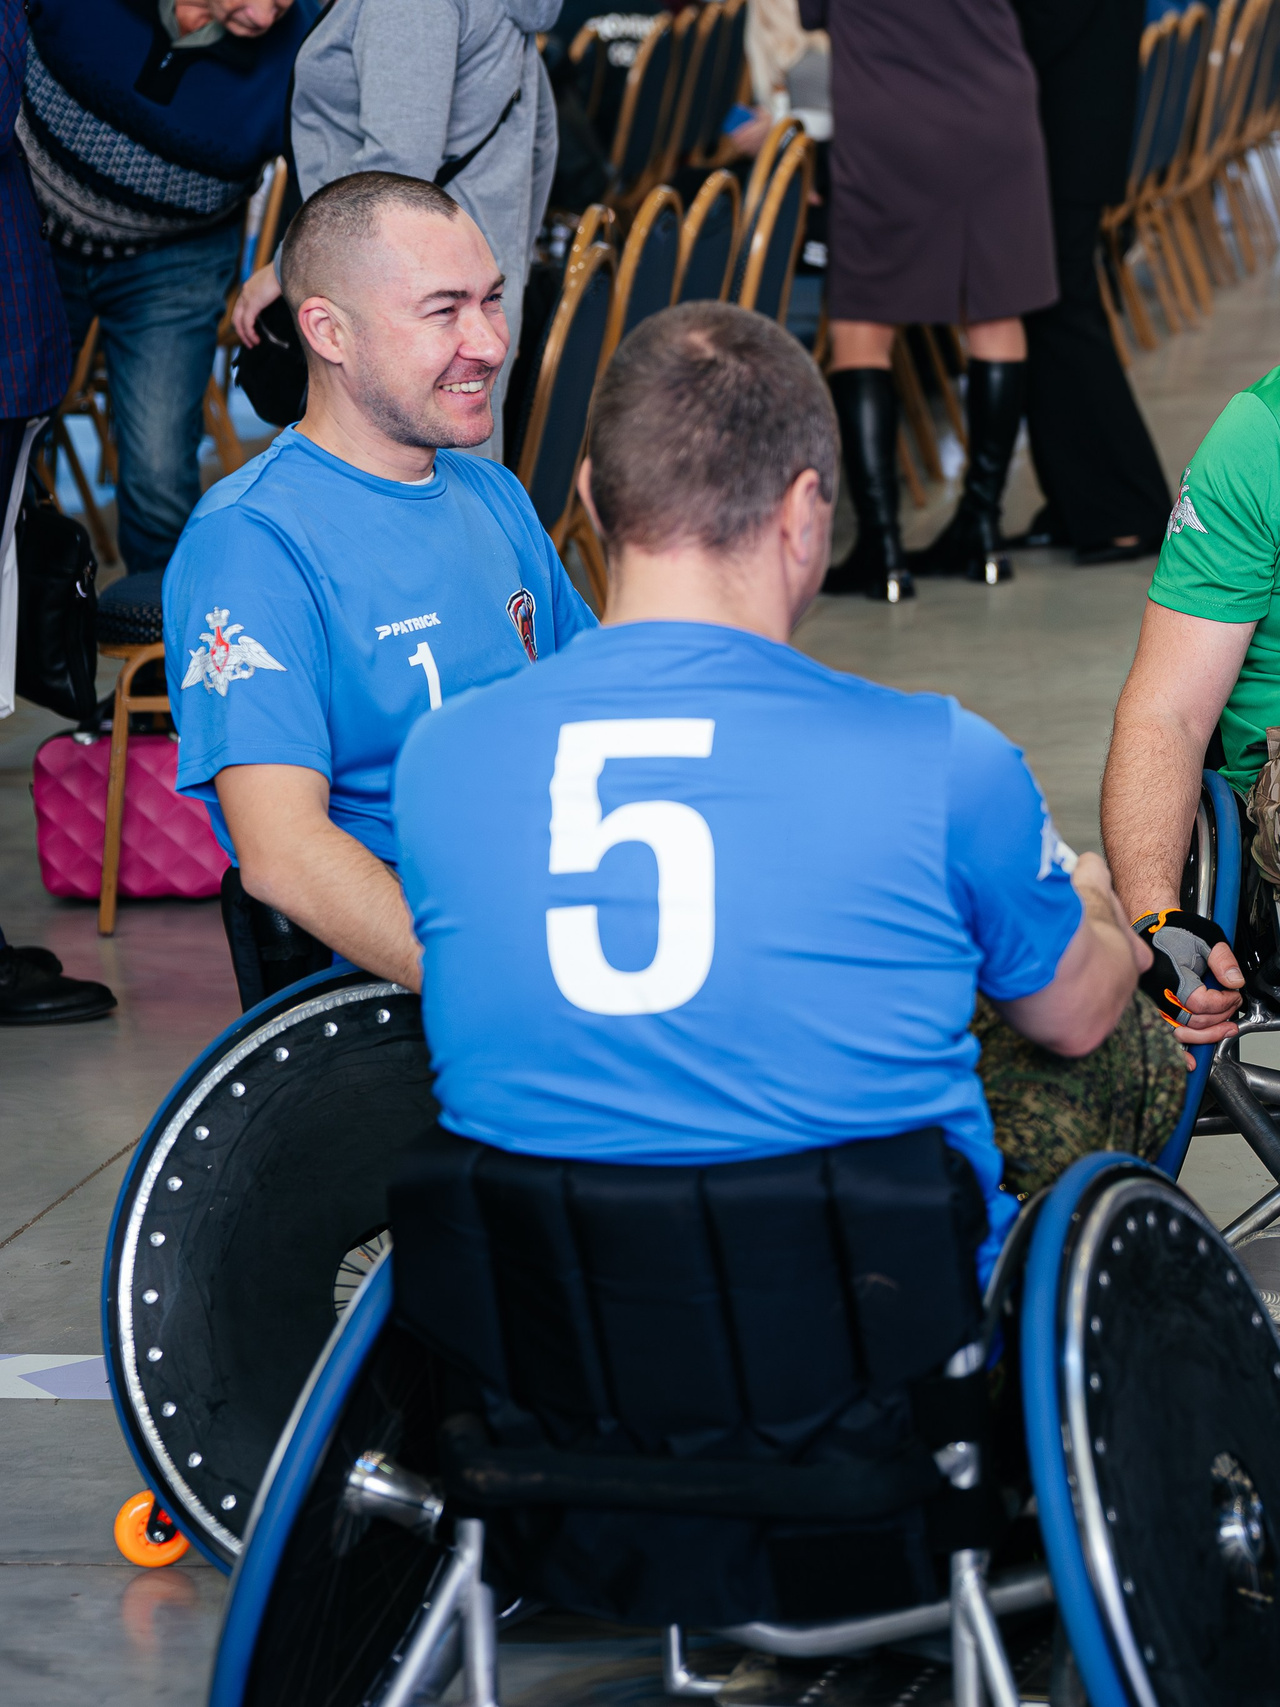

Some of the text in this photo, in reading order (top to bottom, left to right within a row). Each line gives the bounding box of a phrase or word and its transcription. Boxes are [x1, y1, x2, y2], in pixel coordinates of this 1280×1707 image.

[391, 612, 441, 636] PATRICK
[408, 641, 442, 711] 1
[546, 717, 716, 1016] 5
